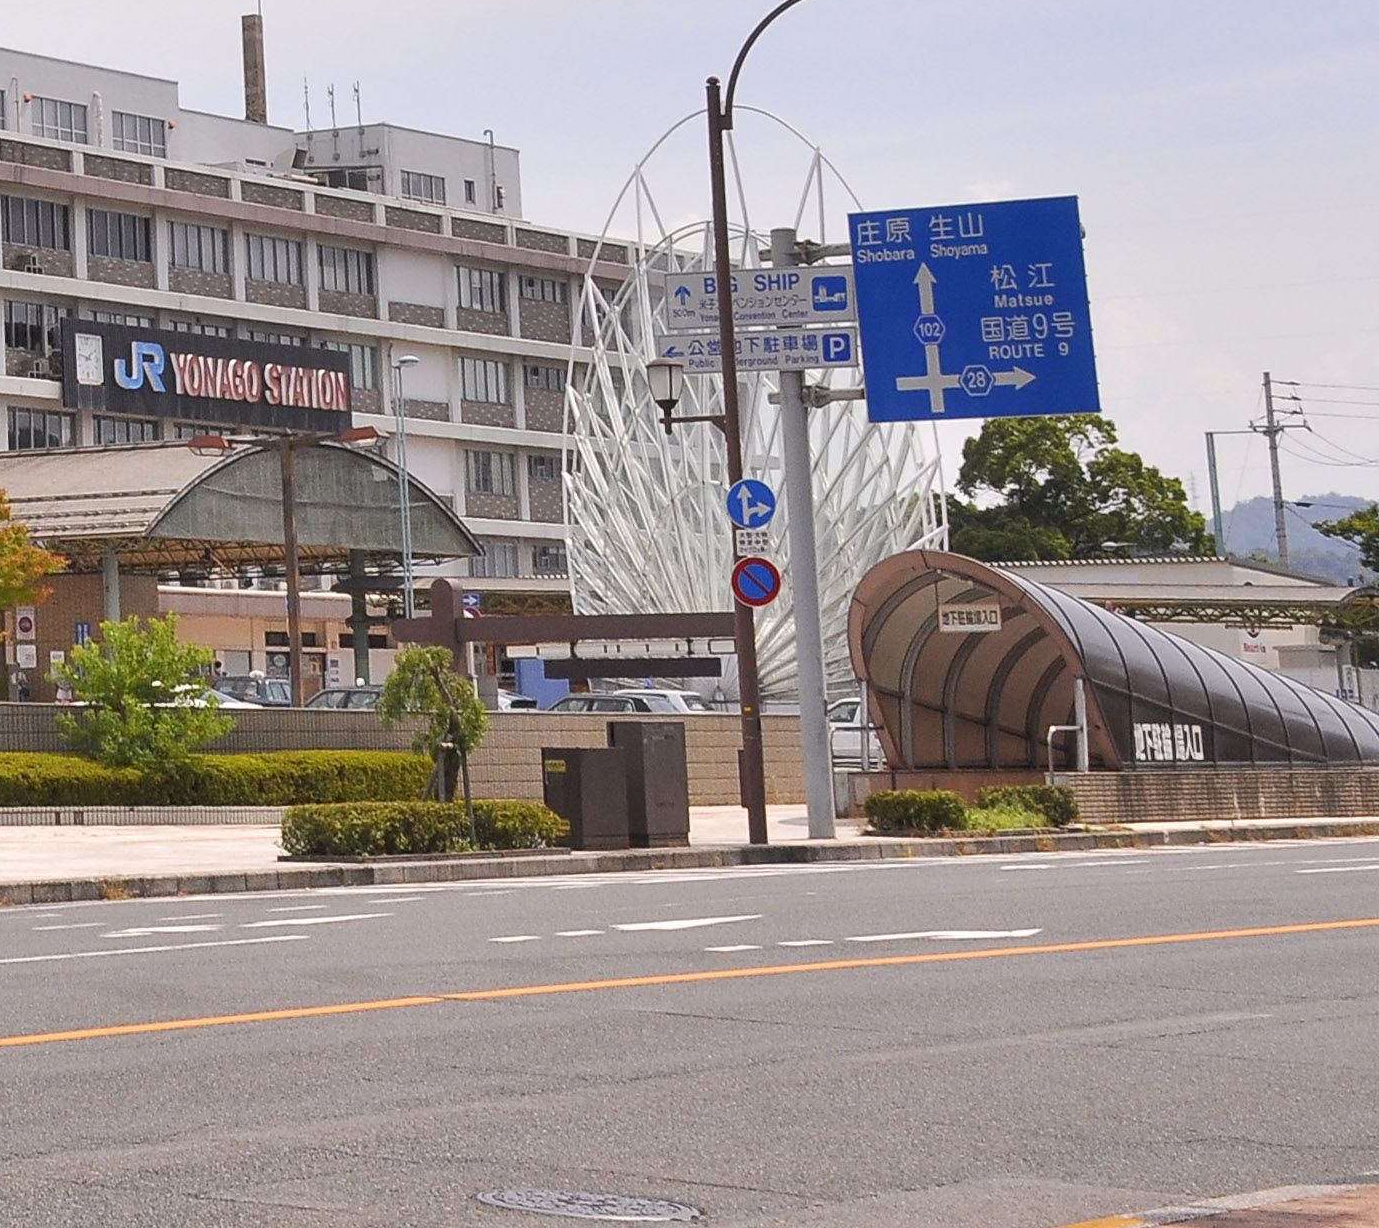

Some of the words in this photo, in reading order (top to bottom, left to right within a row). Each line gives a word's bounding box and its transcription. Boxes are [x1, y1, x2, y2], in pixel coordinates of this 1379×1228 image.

[857, 217, 912, 246] 庄原
[929, 212, 984, 241] 生山
[857, 248, 915, 263] Shobara
[930, 243, 988, 260] Shoyama
[704, 276, 738, 294] BG
[754, 273, 800, 291] SHIP
[990, 263, 1055, 291] 松江
[994, 294, 1054, 308] Matsue
[734, 311, 776, 321] Convention
[782, 309, 809, 319] Center
[919, 323, 940, 337] 102
[981, 311, 1075, 342] 国道9号
[829, 336, 845, 359] P
[989, 343, 1045, 359] ROUTE
[1058, 341, 1069, 356] 9
[689, 358, 714, 368] Public
[785, 353, 820, 364] Parking
[114, 341, 167, 393] JR
[170, 352, 263, 404] YONAGO
[264, 363, 348, 412] STATION
[967, 372, 986, 388] 28
